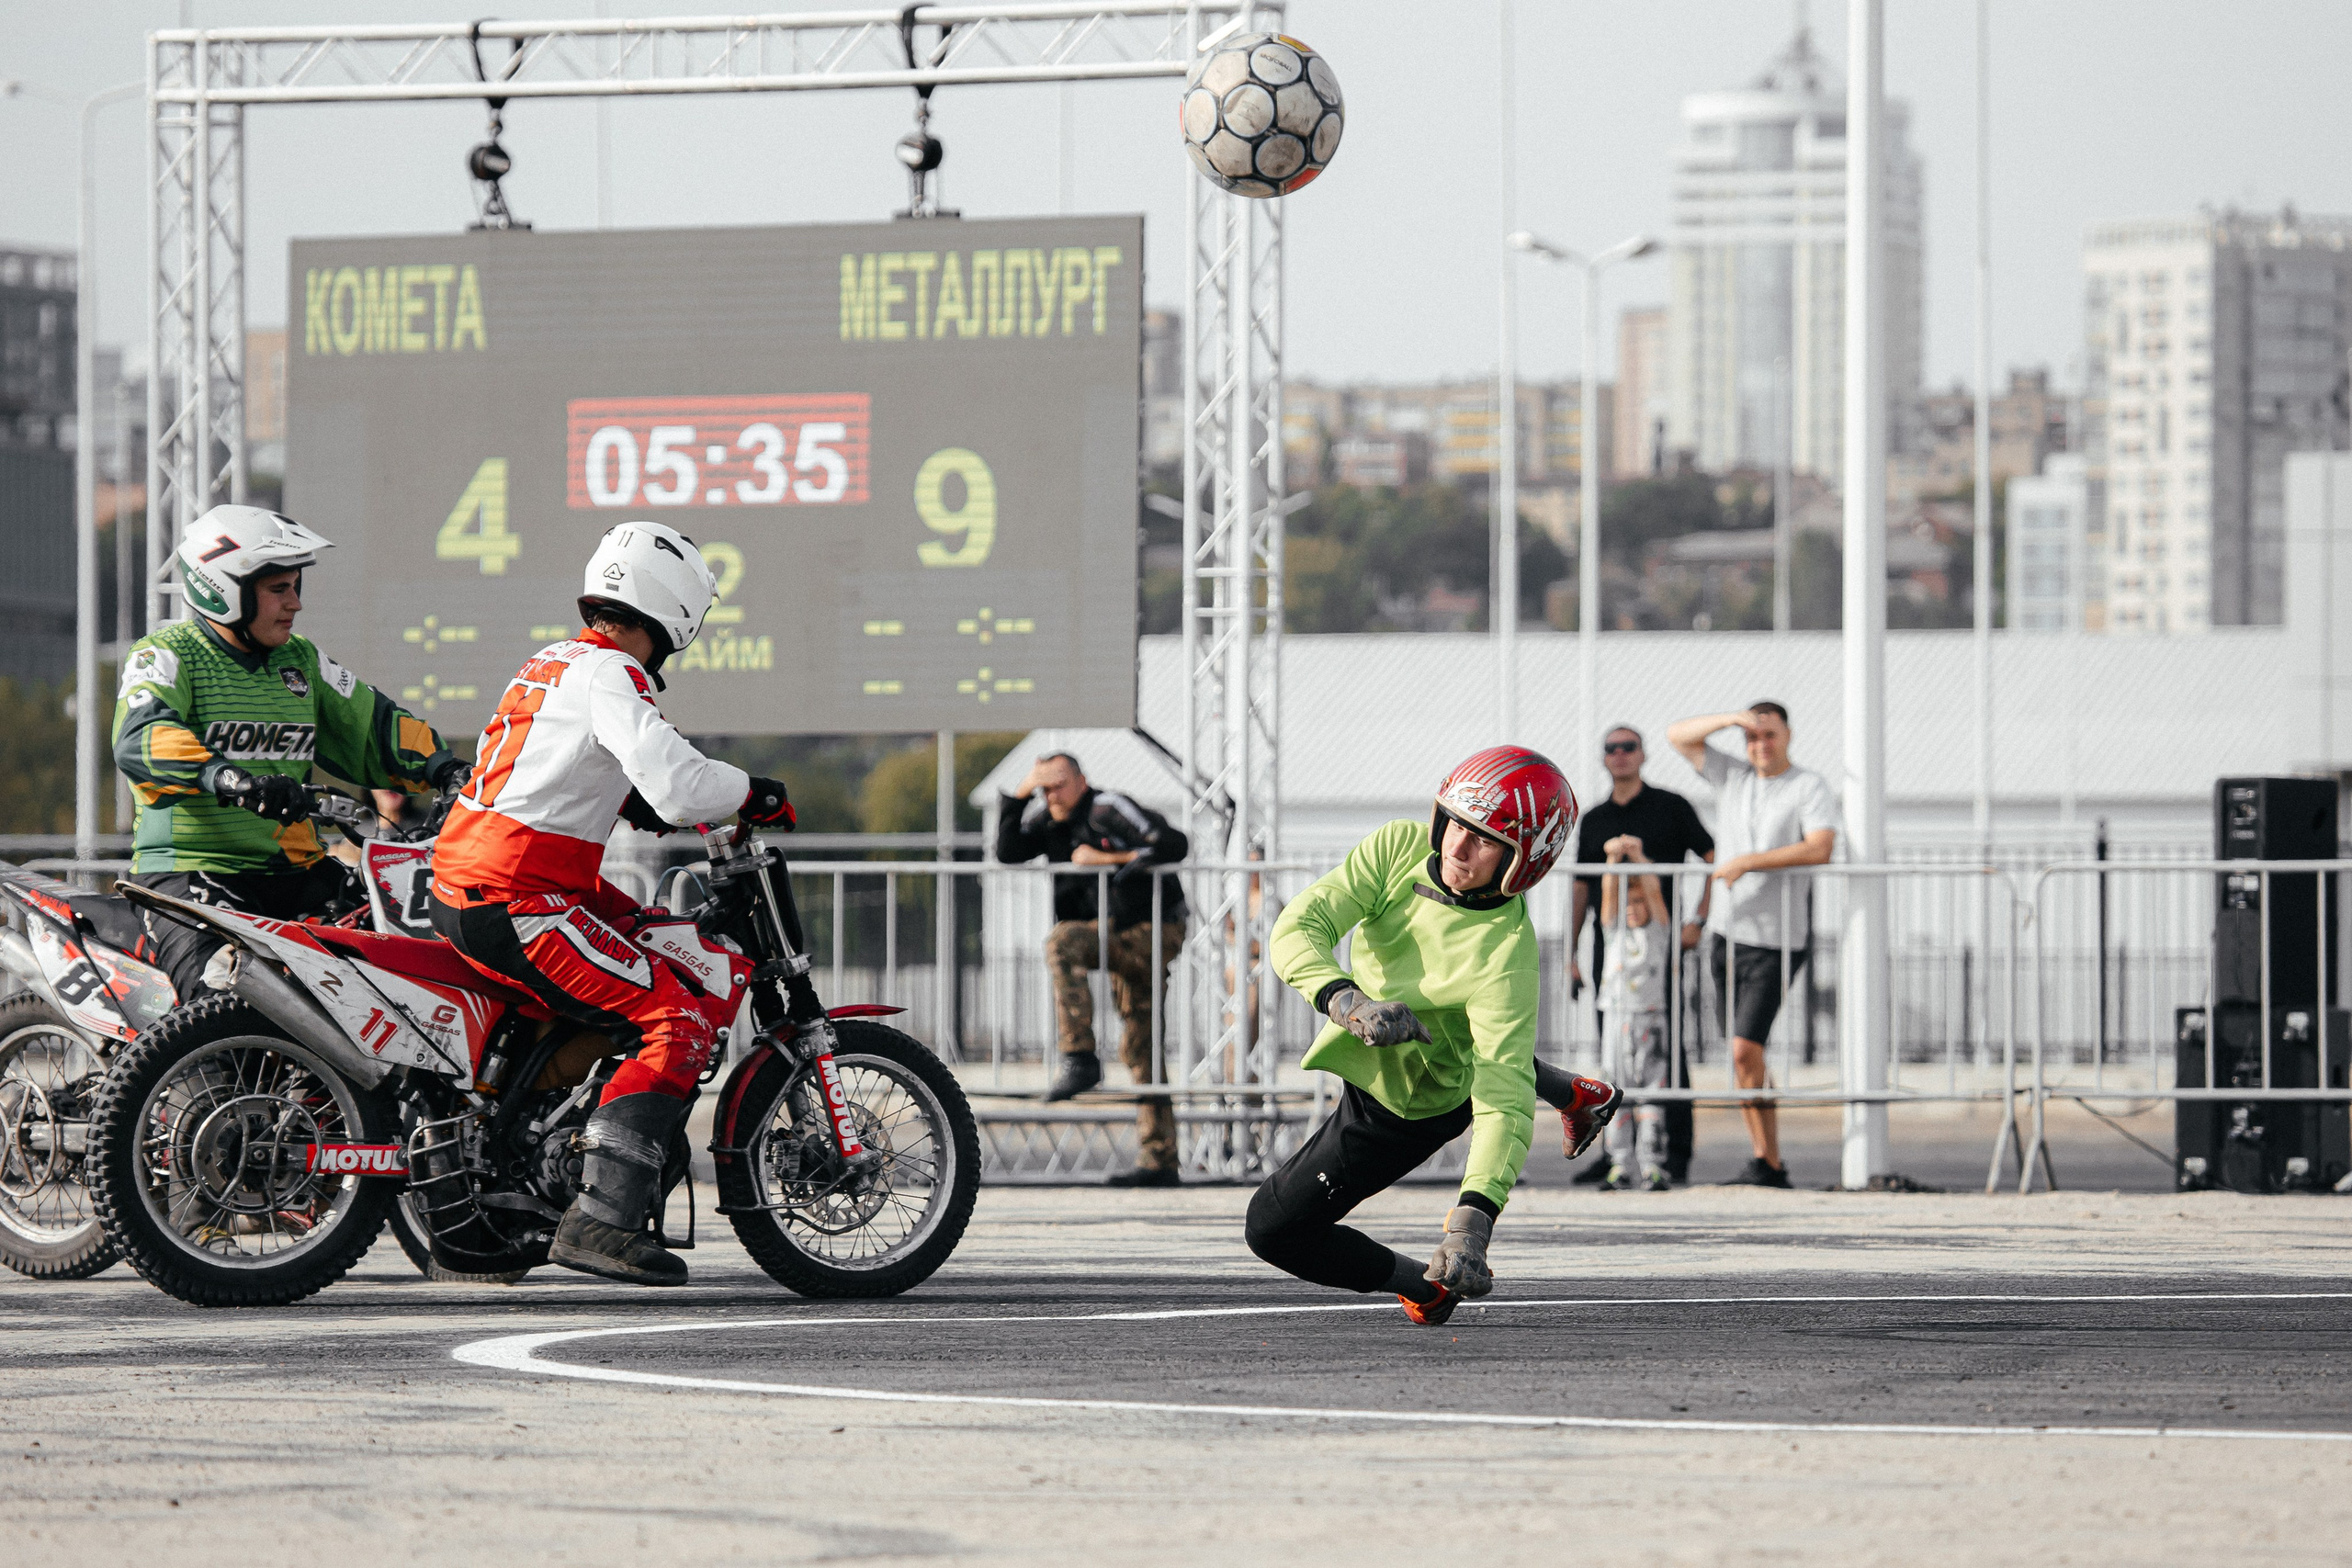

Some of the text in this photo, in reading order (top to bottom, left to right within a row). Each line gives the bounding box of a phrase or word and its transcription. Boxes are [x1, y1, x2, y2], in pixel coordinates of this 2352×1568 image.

[305, 264, 488, 355] КОМЕТА
[840, 245, 1123, 342] МЕТАЛЛУРГ
[585, 422, 850, 505] 05:35
[435, 456, 522, 576] 4
[913, 446, 998, 569] 9
[697, 542, 746, 624] 2
[664, 626, 775, 673] АЙМ
[566, 907, 642, 970] МЕТАЛЛУРГ
[662, 940, 714, 977] GASGAS
[55, 961, 111, 1006] 8
[359, 1007, 398, 1055] 11
[421, 1021, 461, 1036] GASGAS
[820, 1059, 859, 1152] MOTUL
[1580, 1080, 1601, 1095] COPA
[311, 1148, 404, 1171] MOTUL
